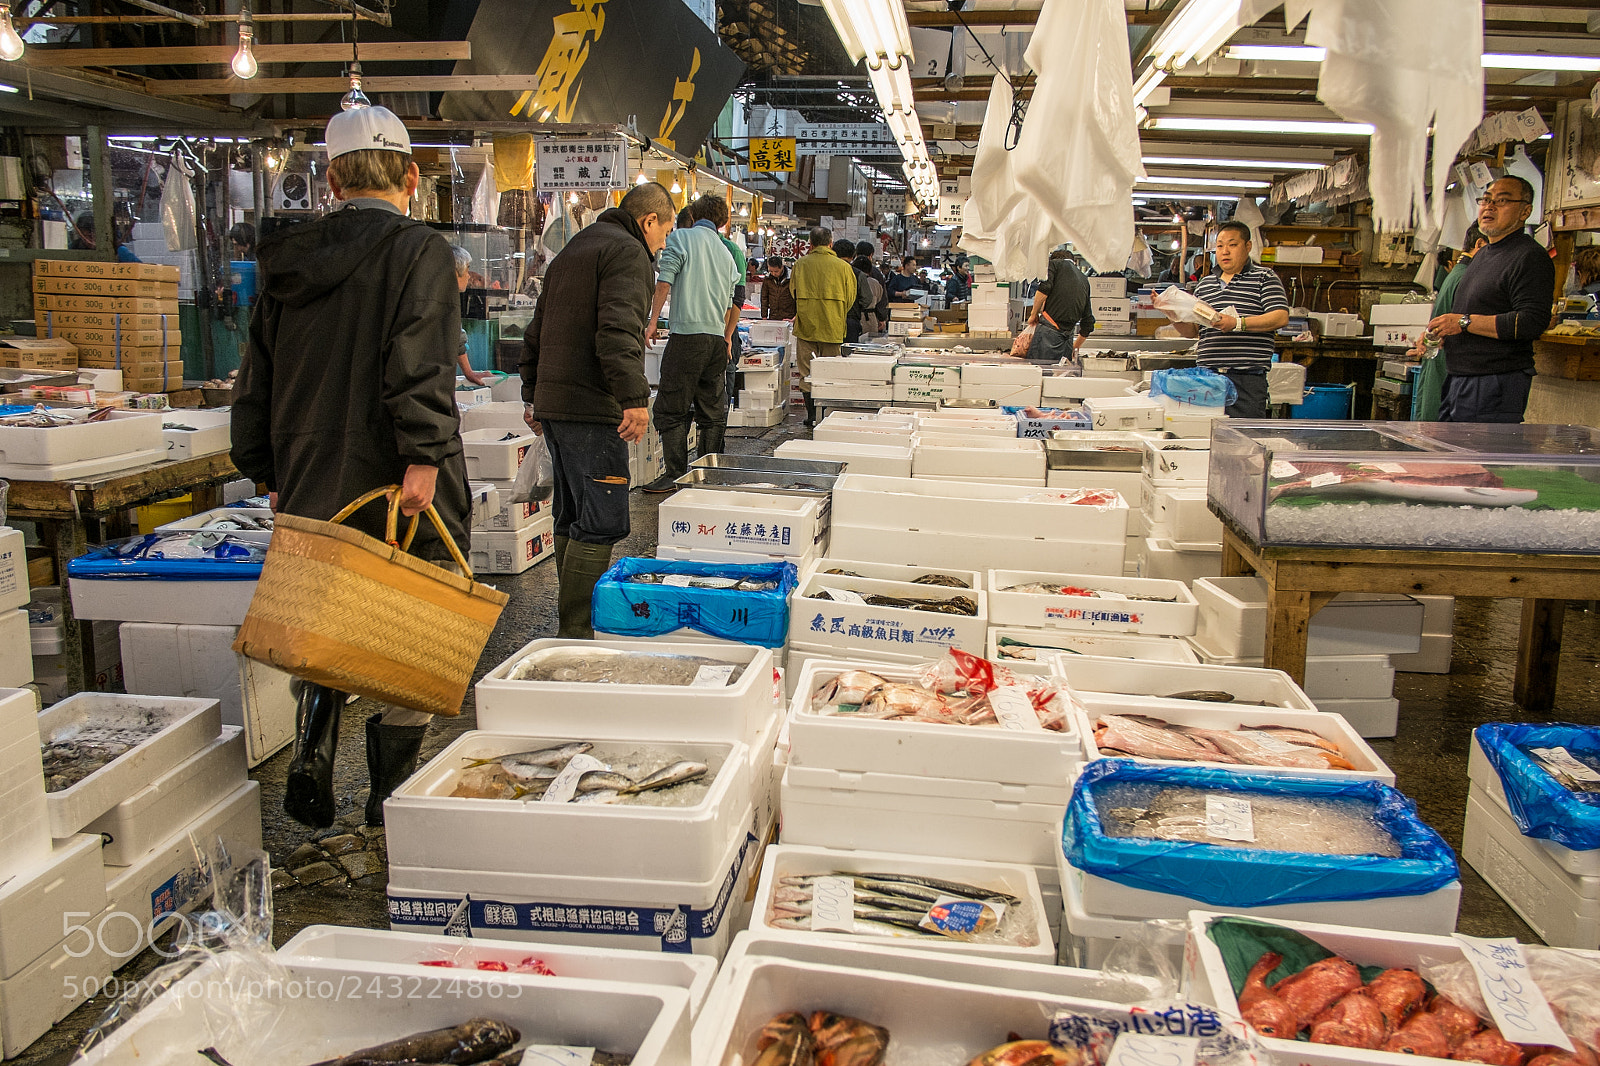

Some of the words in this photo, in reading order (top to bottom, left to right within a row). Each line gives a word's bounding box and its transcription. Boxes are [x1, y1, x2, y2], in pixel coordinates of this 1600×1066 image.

[761, 139, 783, 150] えび
[752, 150, 794, 170] 高梨
[86, 264, 104, 275] 300g
[83, 282, 102, 293] 300g
[85, 300, 103, 310] 300g
[83, 315, 102, 325] 300g
[85, 332, 103, 342] 300g
[83, 347, 102, 357] 300g
[1024, 429, 1045, 438] カスベ
[671, 520, 691, 534] (株)
[697, 523, 717, 536] 丸イ
[724, 522, 781, 539] 佐藤海産
[730, 607, 749, 627] 川
[848, 623, 914, 644] 高級魚貝類
[919, 626, 956, 641] ハマグチ
[484, 903, 518, 926] 鮮魚
[530, 906, 639, 926] 式根島漁業協同組合
